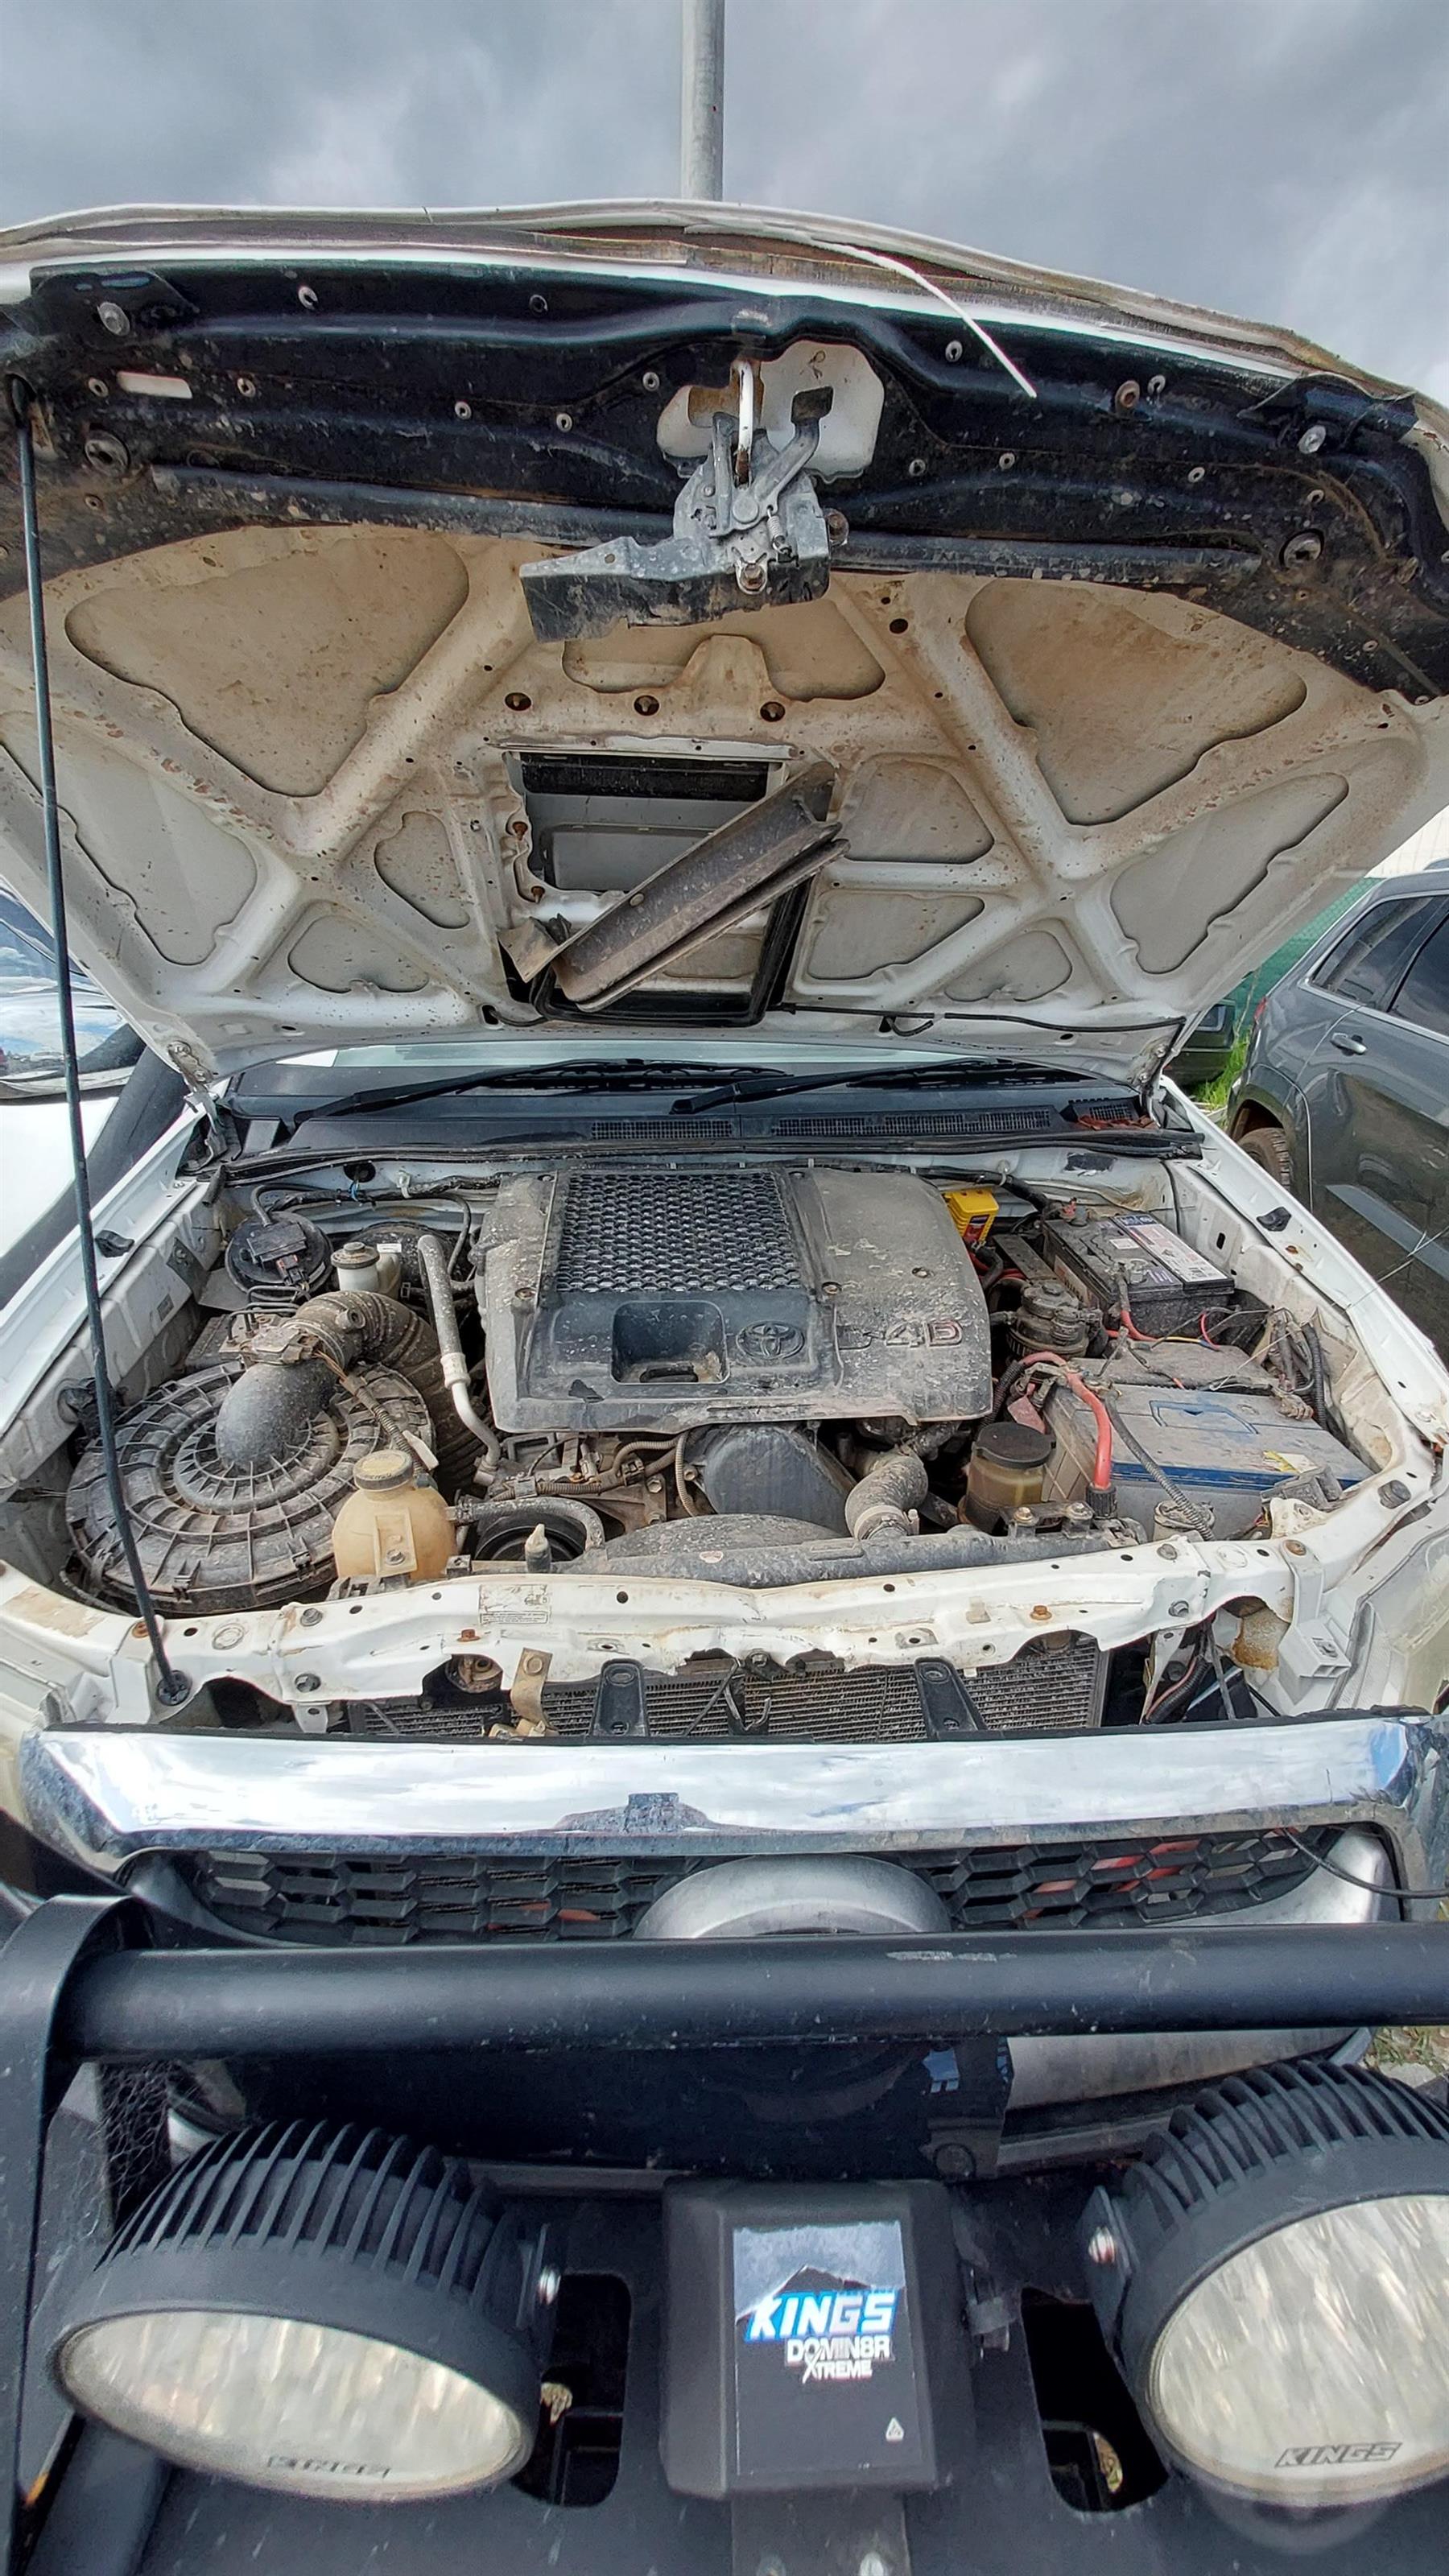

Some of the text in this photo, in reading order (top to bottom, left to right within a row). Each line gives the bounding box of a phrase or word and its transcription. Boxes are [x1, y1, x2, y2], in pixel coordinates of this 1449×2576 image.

[745, 2291, 899, 2342] KINGS
[786, 2335, 892, 2364] DOMIN8R
[802, 2355, 873, 2384] XTREME
[1274, 2442, 1403, 2468] KINGS
